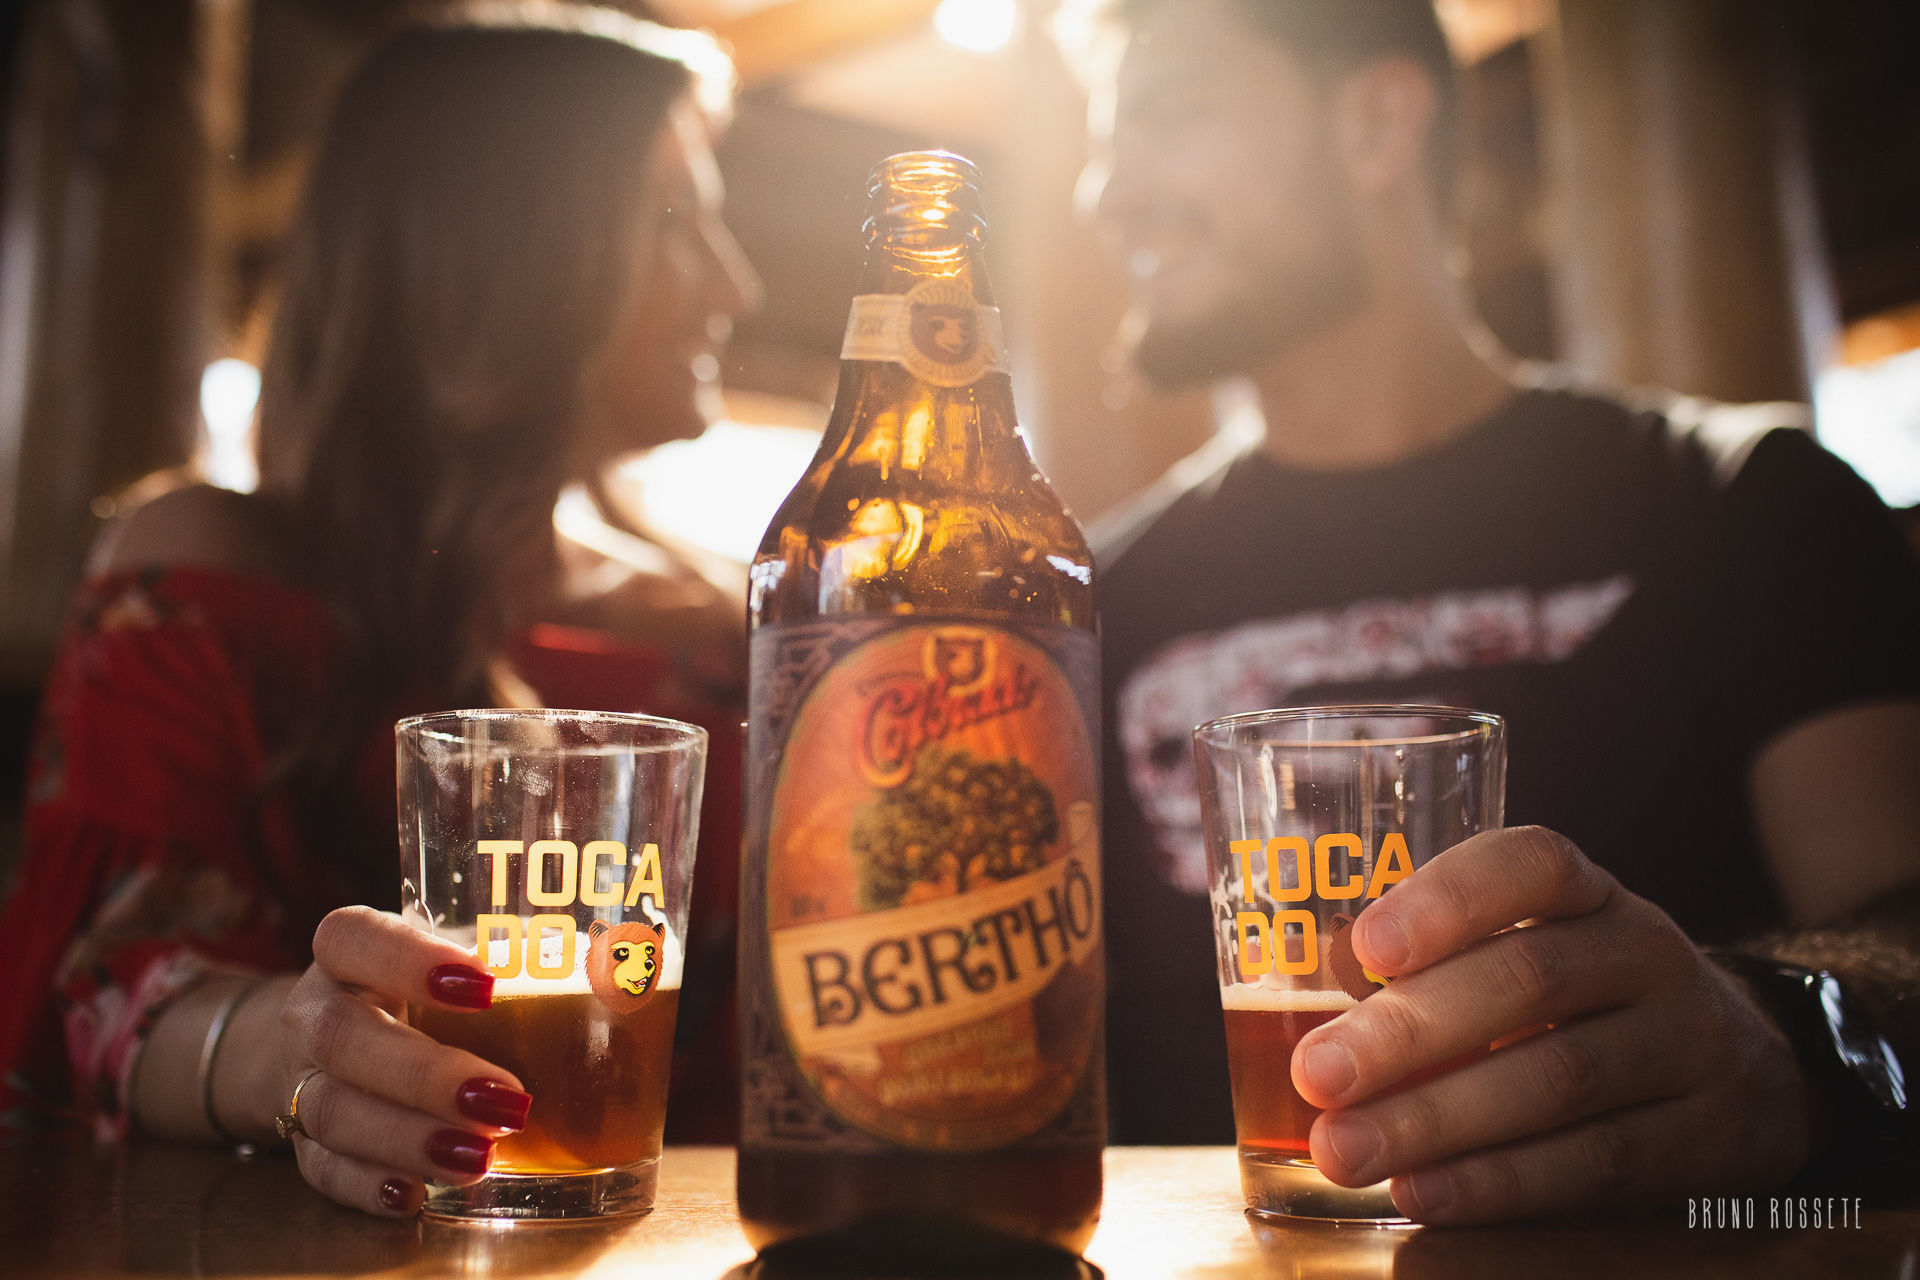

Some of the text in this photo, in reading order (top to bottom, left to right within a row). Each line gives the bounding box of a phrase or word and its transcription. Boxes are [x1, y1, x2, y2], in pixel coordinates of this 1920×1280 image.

[476, 840, 666, 909] TOCA
[1229, 832, 1416, 904] TOCA
[476, 913, 577, 980] DO
[802, 859, 1095, 1028] BERTHÔ
[1236, 909, 1319, 976] DO
